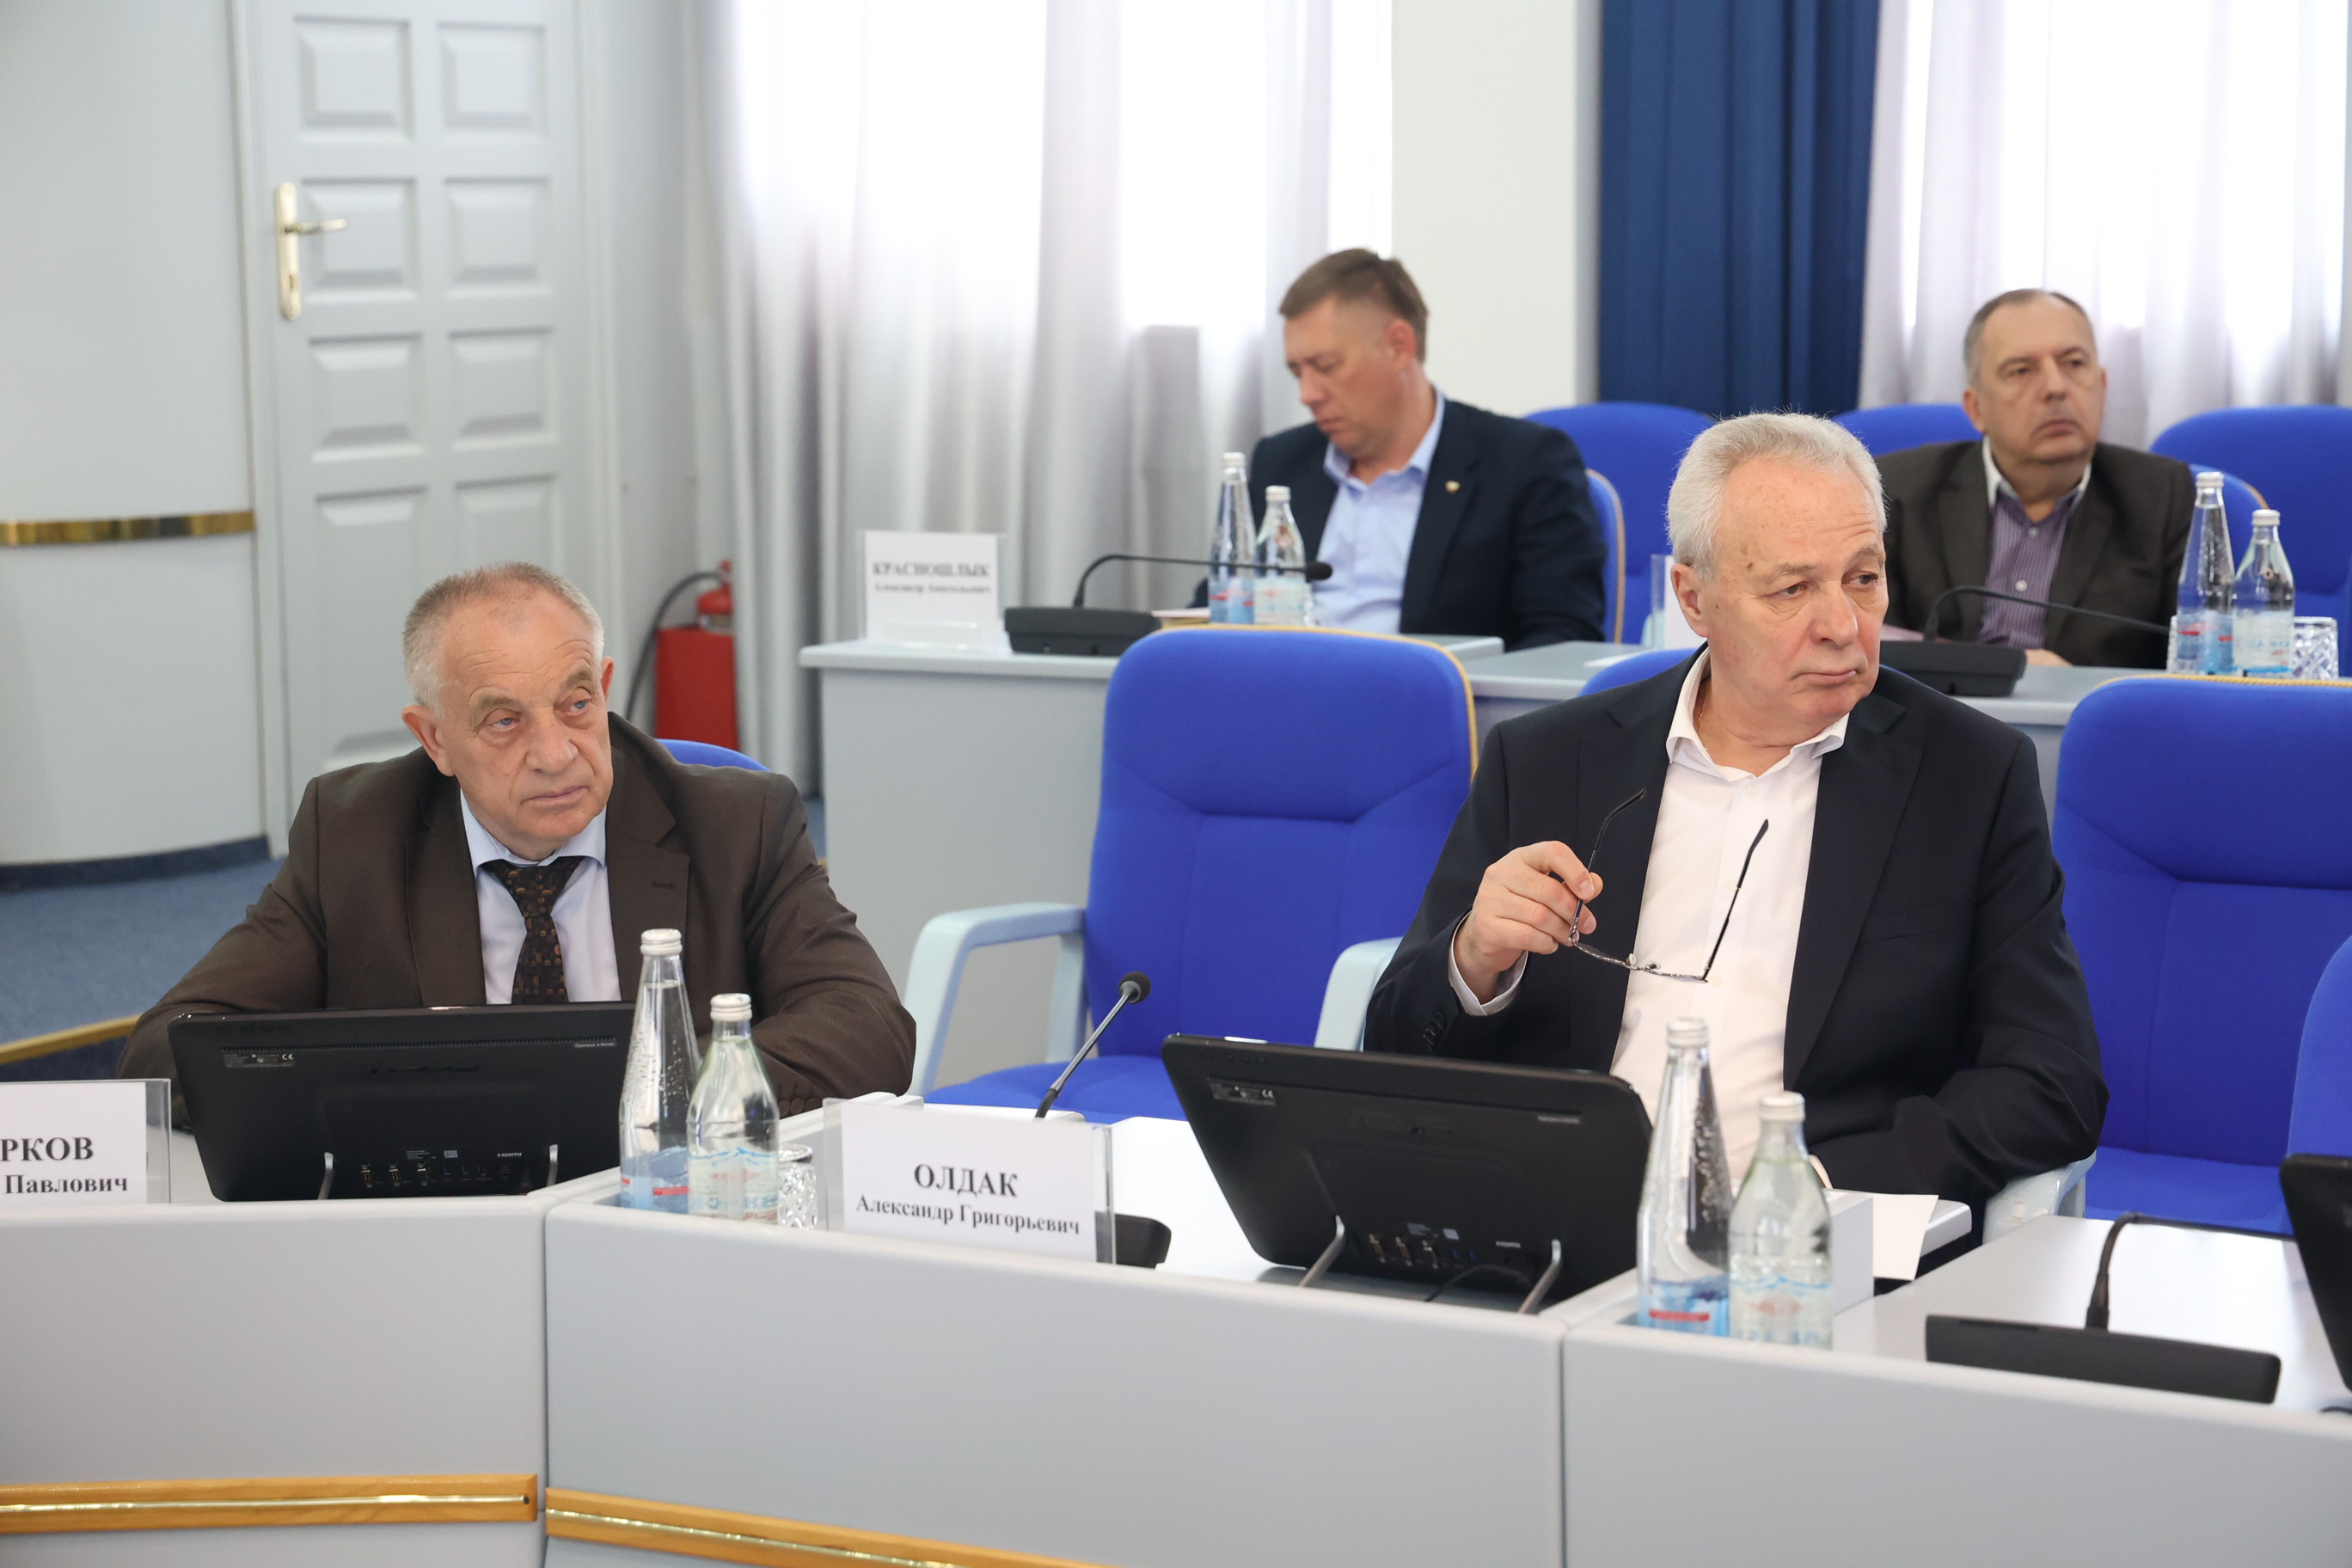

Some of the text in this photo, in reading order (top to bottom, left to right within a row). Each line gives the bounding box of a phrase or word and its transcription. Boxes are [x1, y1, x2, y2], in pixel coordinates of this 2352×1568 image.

[0, 1136, 94, 1161] РКОВ
[5, 1174, 128, 1194] Павлович
[914, 1164, 1019, 1197] ОЛДАК
[857, 1195, 1080, 1234] Александр Григорьевич
